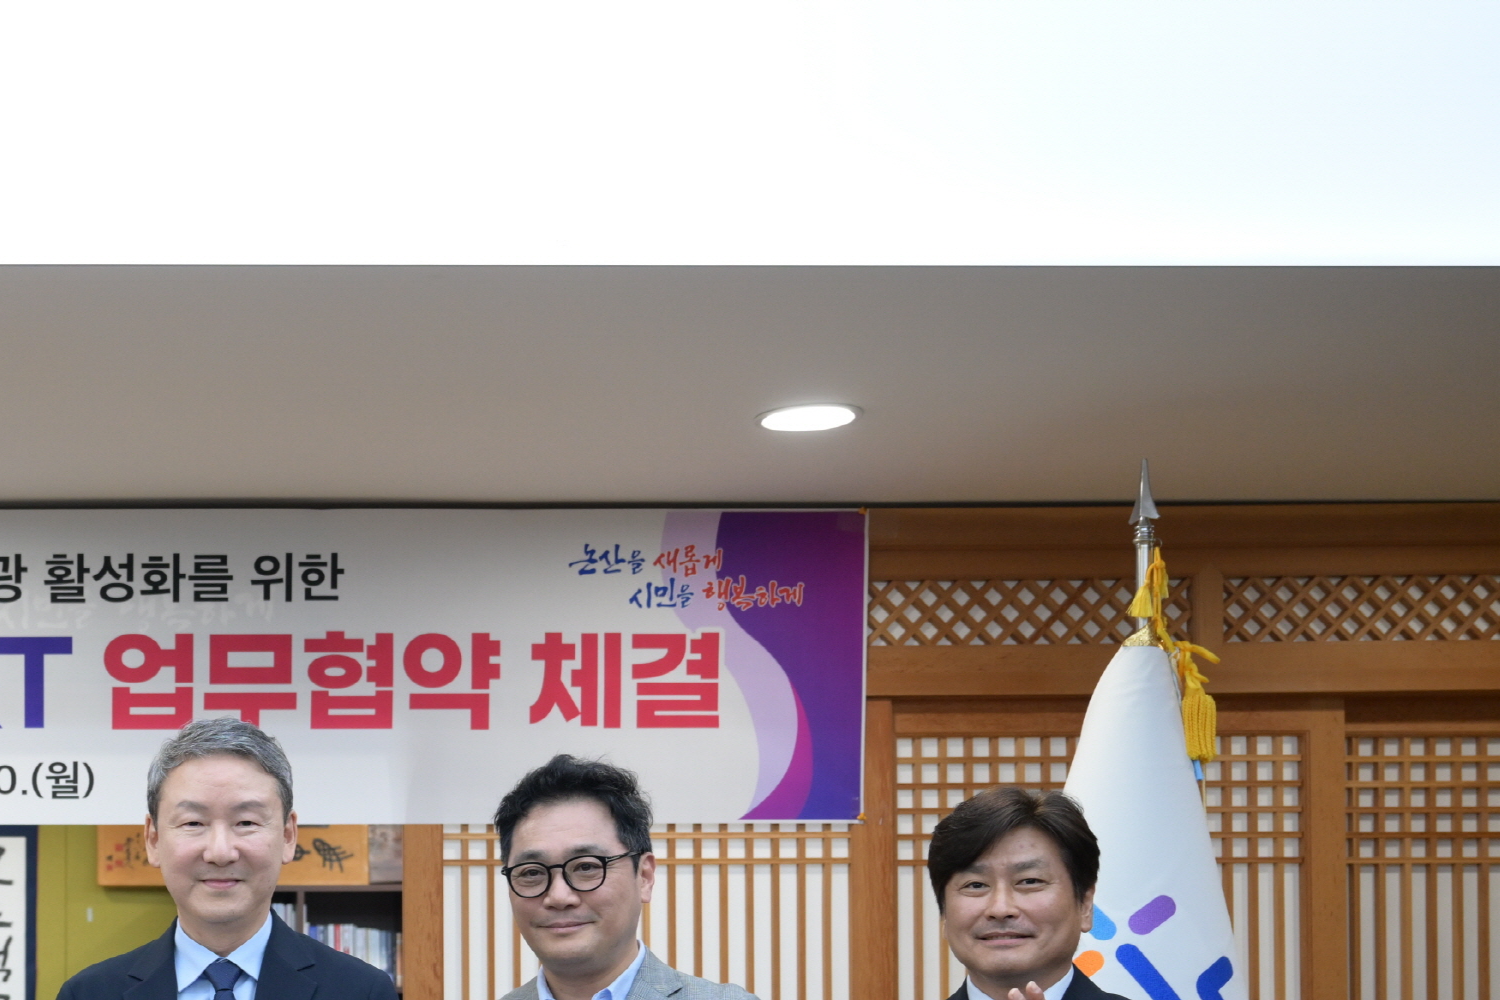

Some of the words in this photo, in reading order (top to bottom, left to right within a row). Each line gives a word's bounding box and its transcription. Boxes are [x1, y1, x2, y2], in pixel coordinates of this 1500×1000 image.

[43, 553, 235, 604] 활성화를
[250, 553, 345, 603] 위한
[569, 543, 645, 575] 논산을
[629, 578, 694, 609] 시민을
[102, 629, 501, 731] 업무협약
[528, 629, 720, 730] 체결
